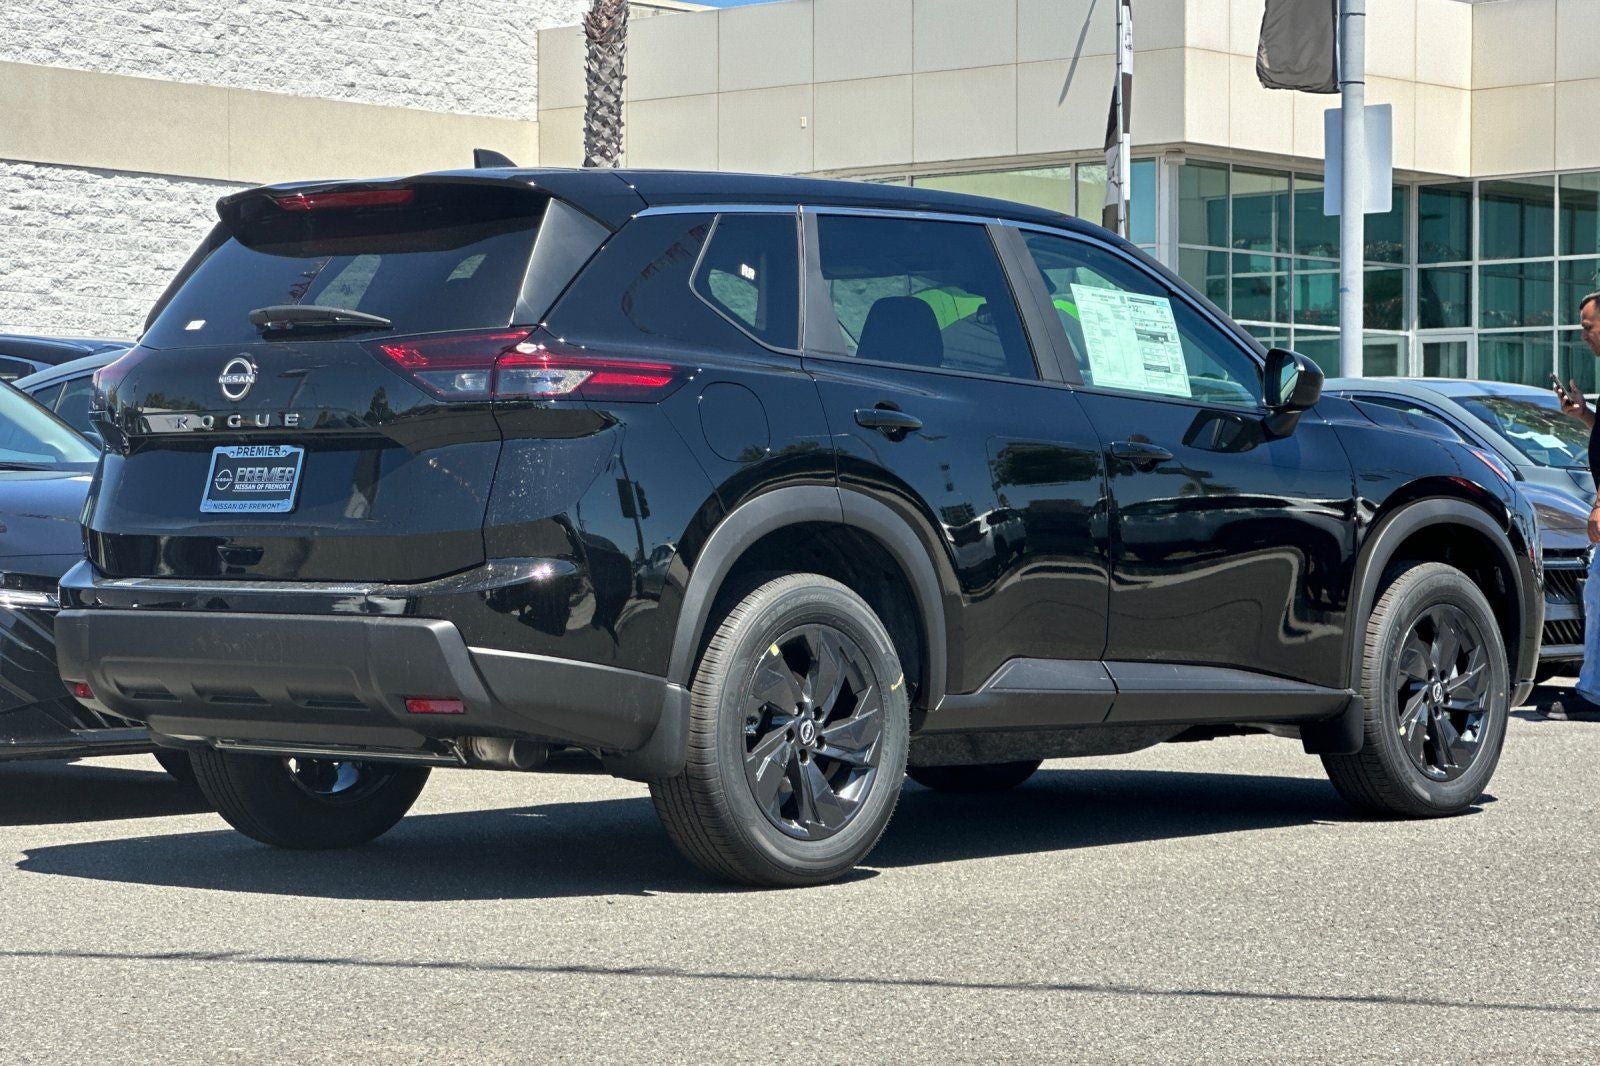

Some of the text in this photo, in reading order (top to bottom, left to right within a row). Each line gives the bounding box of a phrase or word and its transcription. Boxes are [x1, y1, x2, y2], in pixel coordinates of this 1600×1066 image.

[218, 374, 255, 384] NISSAN
[175, 413, 299, 430] ROGUE
[236, 446, 281, 457] PREMIER
[235, 467, 296, 482] PREMIER
